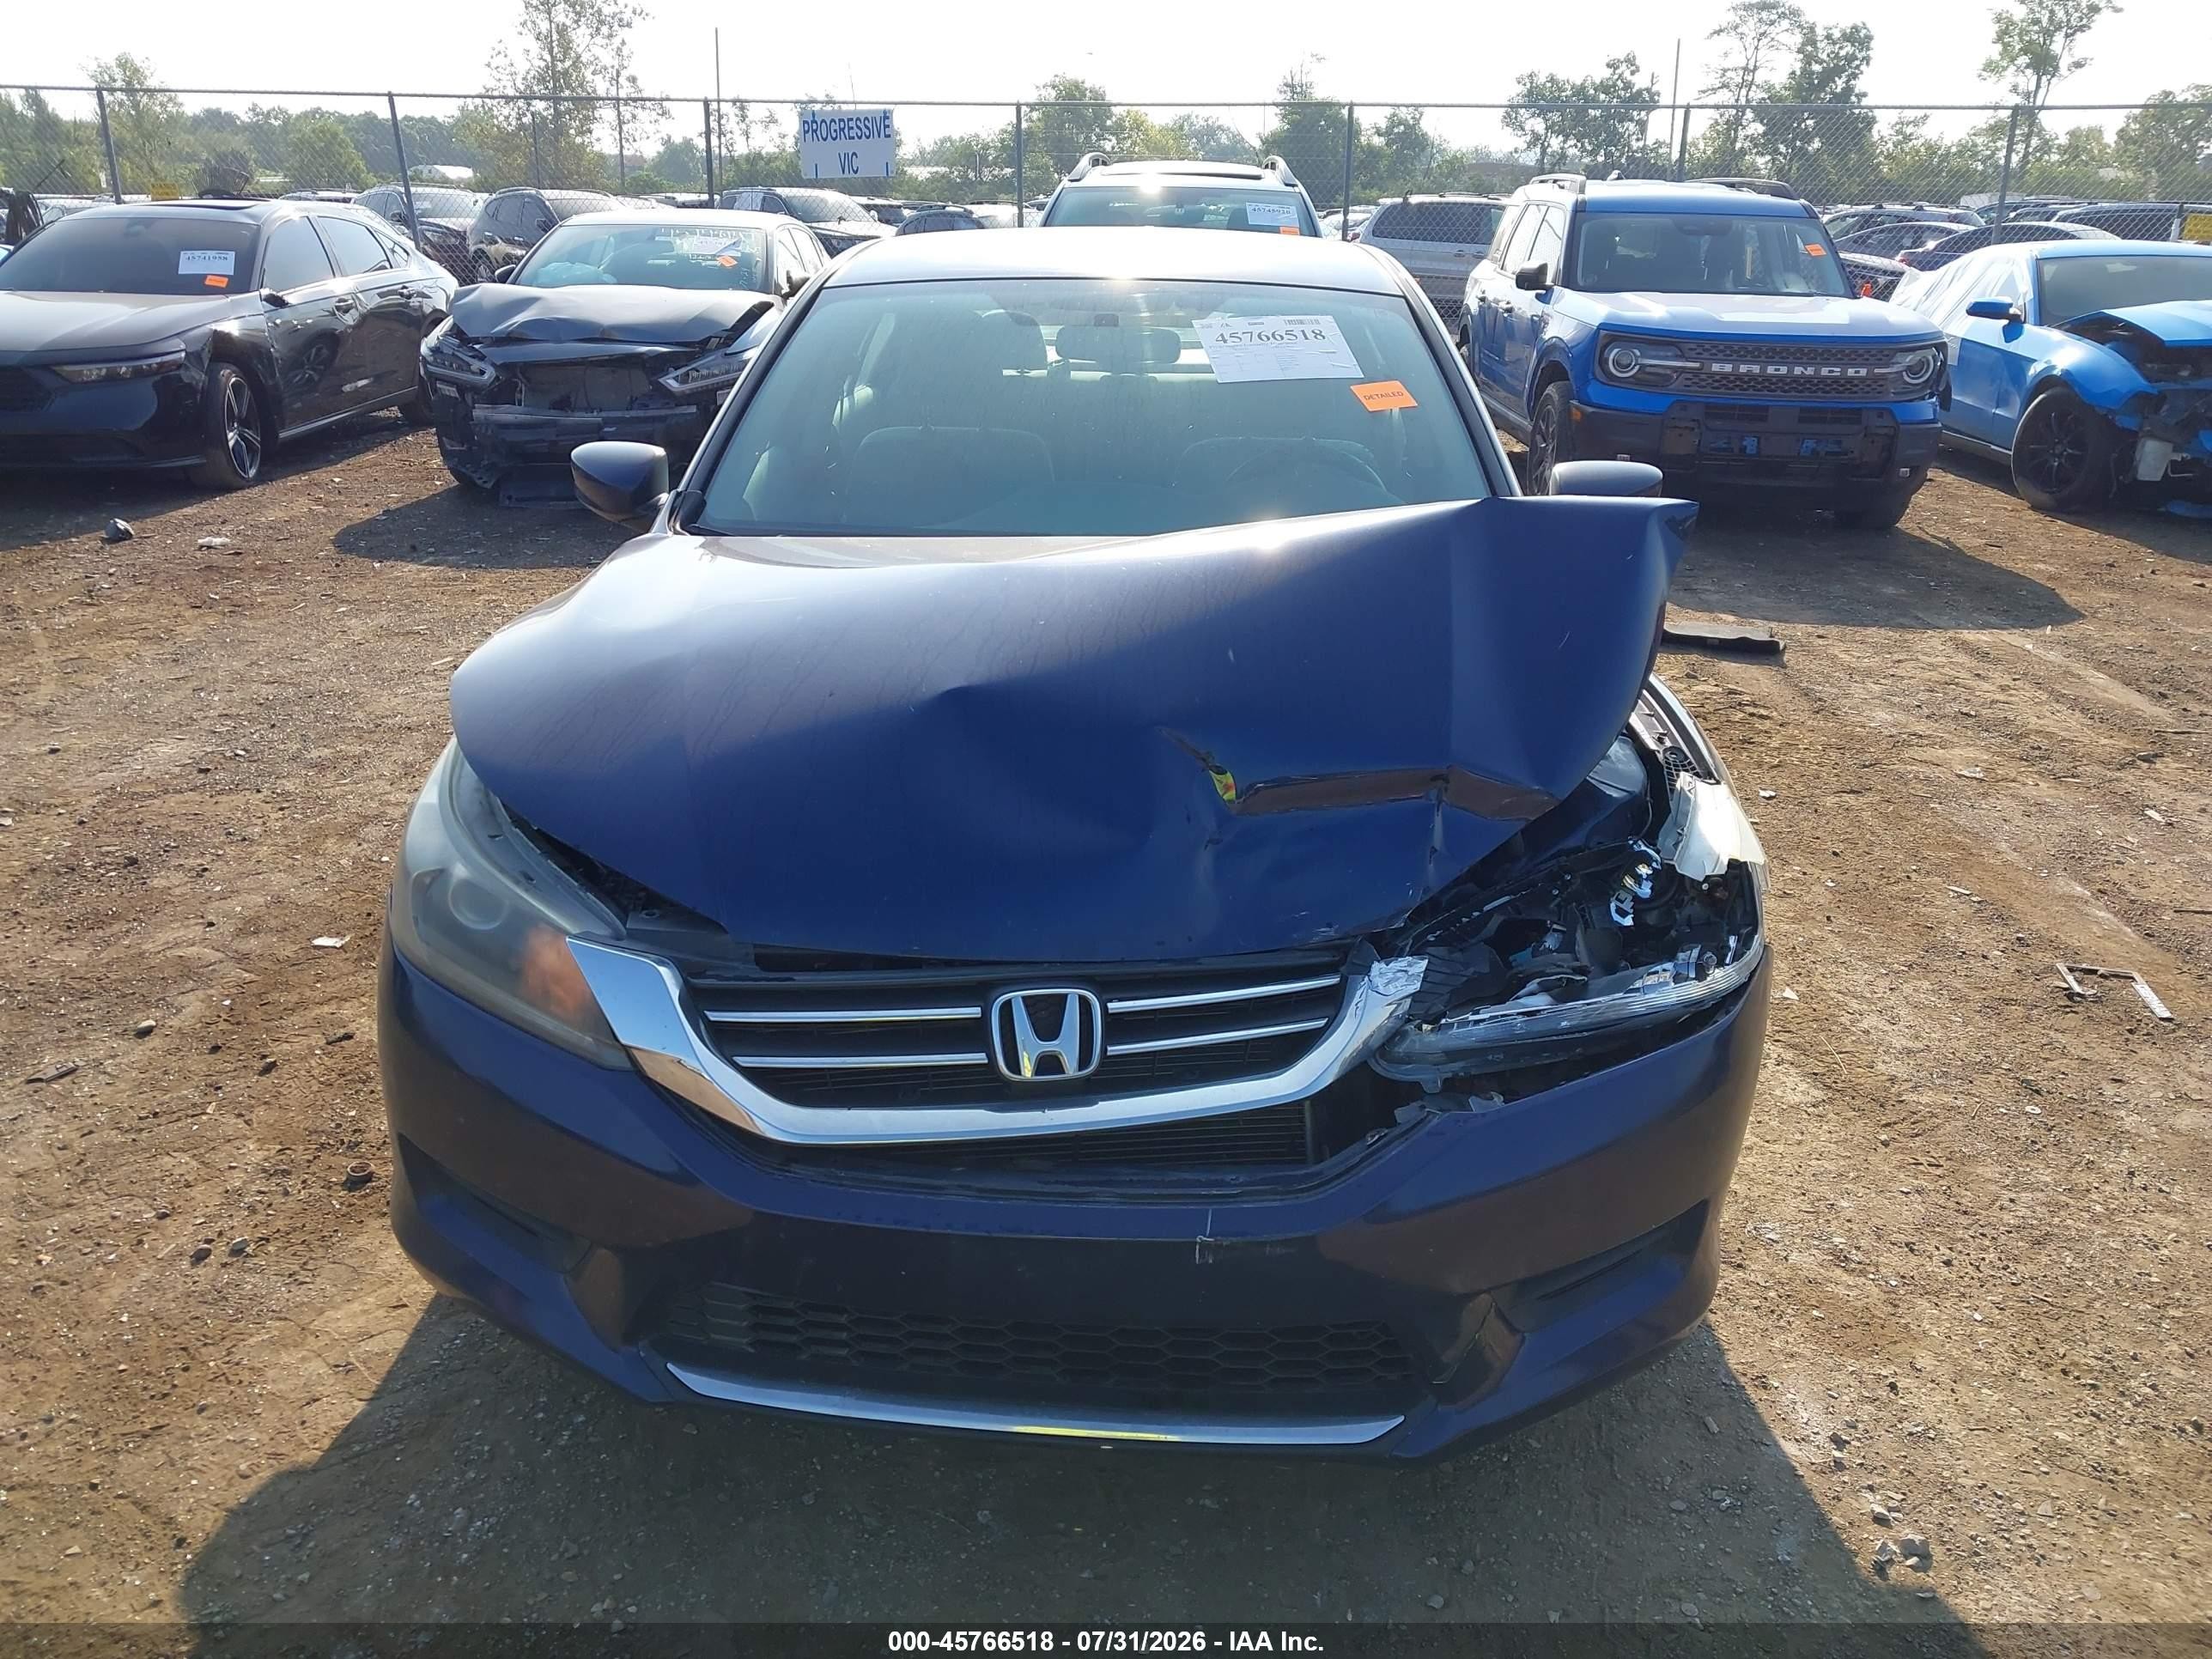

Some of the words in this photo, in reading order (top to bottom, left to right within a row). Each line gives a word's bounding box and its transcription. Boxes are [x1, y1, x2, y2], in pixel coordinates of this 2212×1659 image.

[802, 115, 891, 143] PROGRESSIVE
[837, 151, 860, 175] VIC
[1215, 328, 1326, 344] 45766518
[1711, 362, 1869, 377] BRONCO
[1362, 391, 1404, 401] DETAILED
